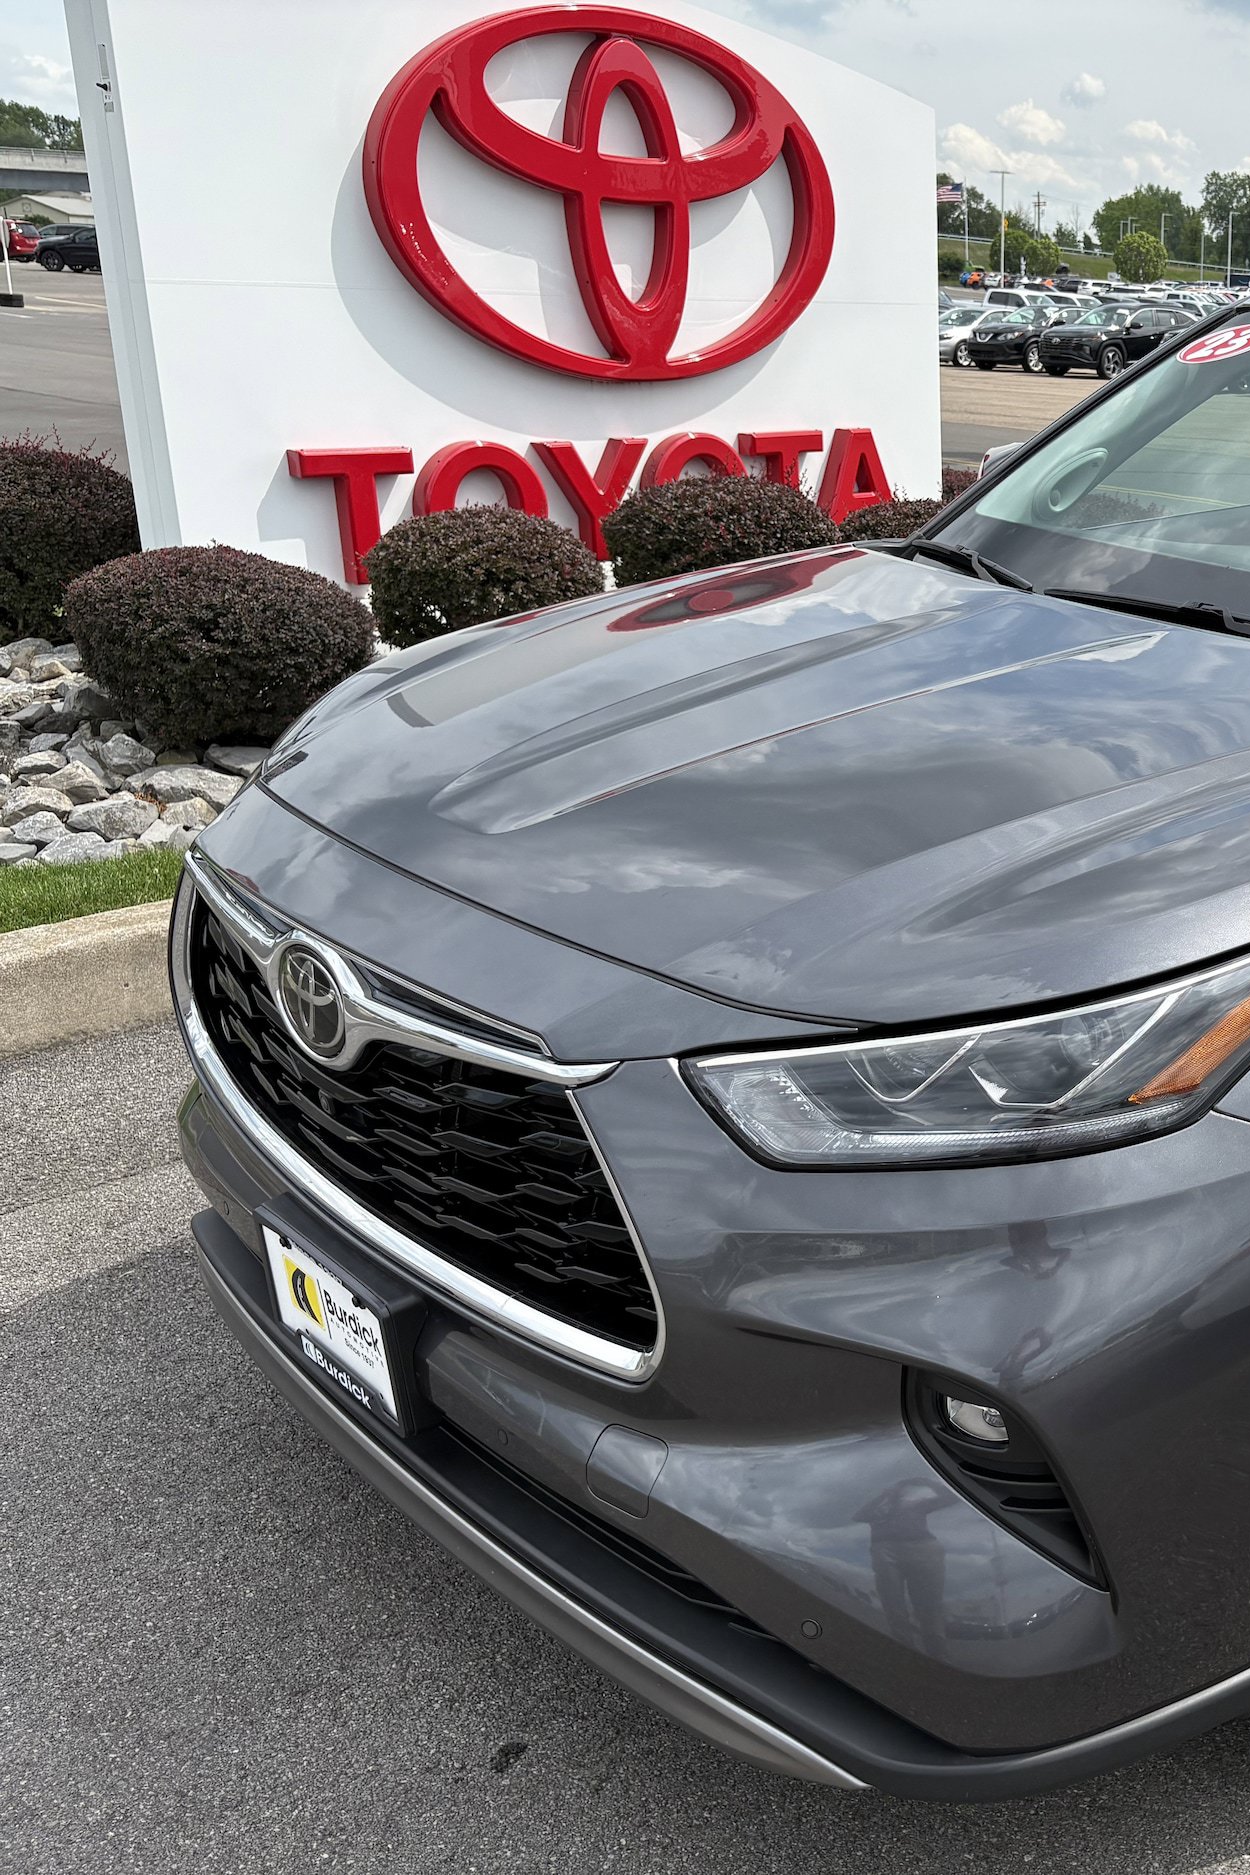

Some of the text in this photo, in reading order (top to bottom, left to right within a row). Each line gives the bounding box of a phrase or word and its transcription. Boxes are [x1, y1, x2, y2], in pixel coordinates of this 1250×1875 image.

[323, 1289, 383, 1360] Burdick
[330, 1317, 385, 1368] AUTOMOTIVE
[315, 1349, 372, 1410] Burdick
